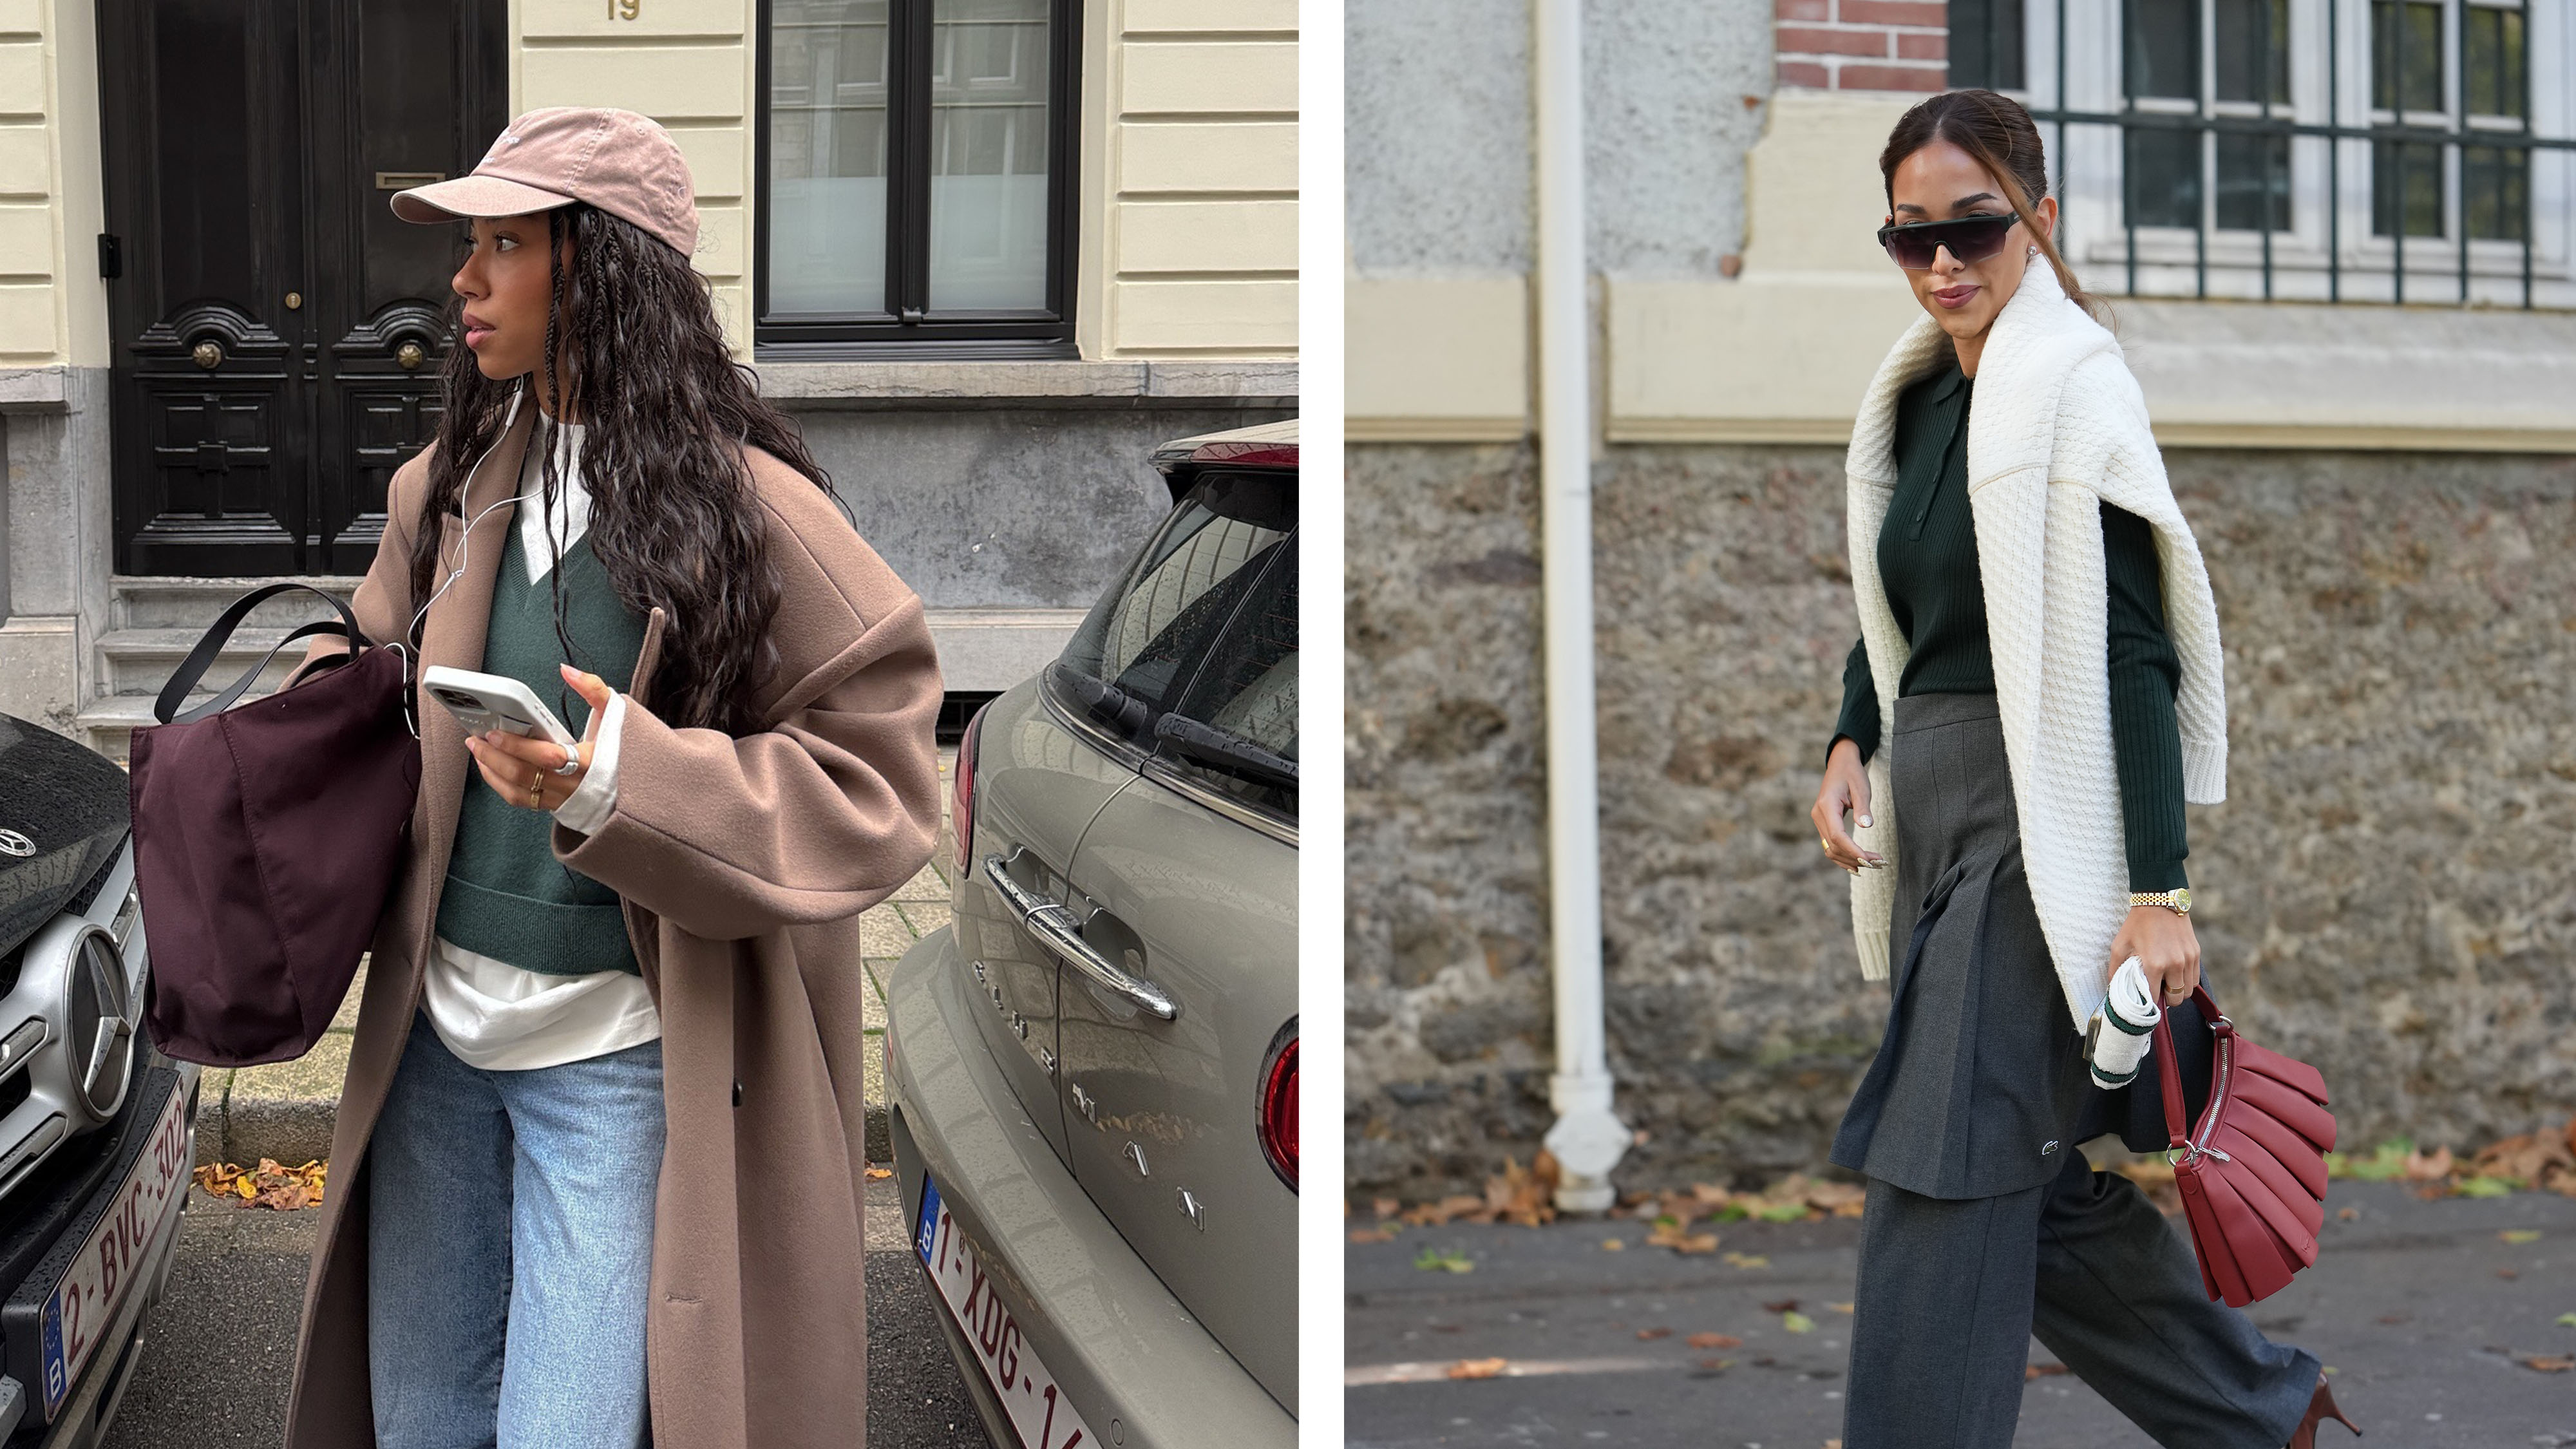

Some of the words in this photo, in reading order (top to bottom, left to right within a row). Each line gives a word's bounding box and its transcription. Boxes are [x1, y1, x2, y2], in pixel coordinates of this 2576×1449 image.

[608, 0, 639, 20] 19
[49, 1358, 62, 1401] B
[65, 1099, 184, 1366] 2-BVC-302
[922, 1220, 932, 1252] B
[939, 1211, 1083, 1449] 1-XDG-1
